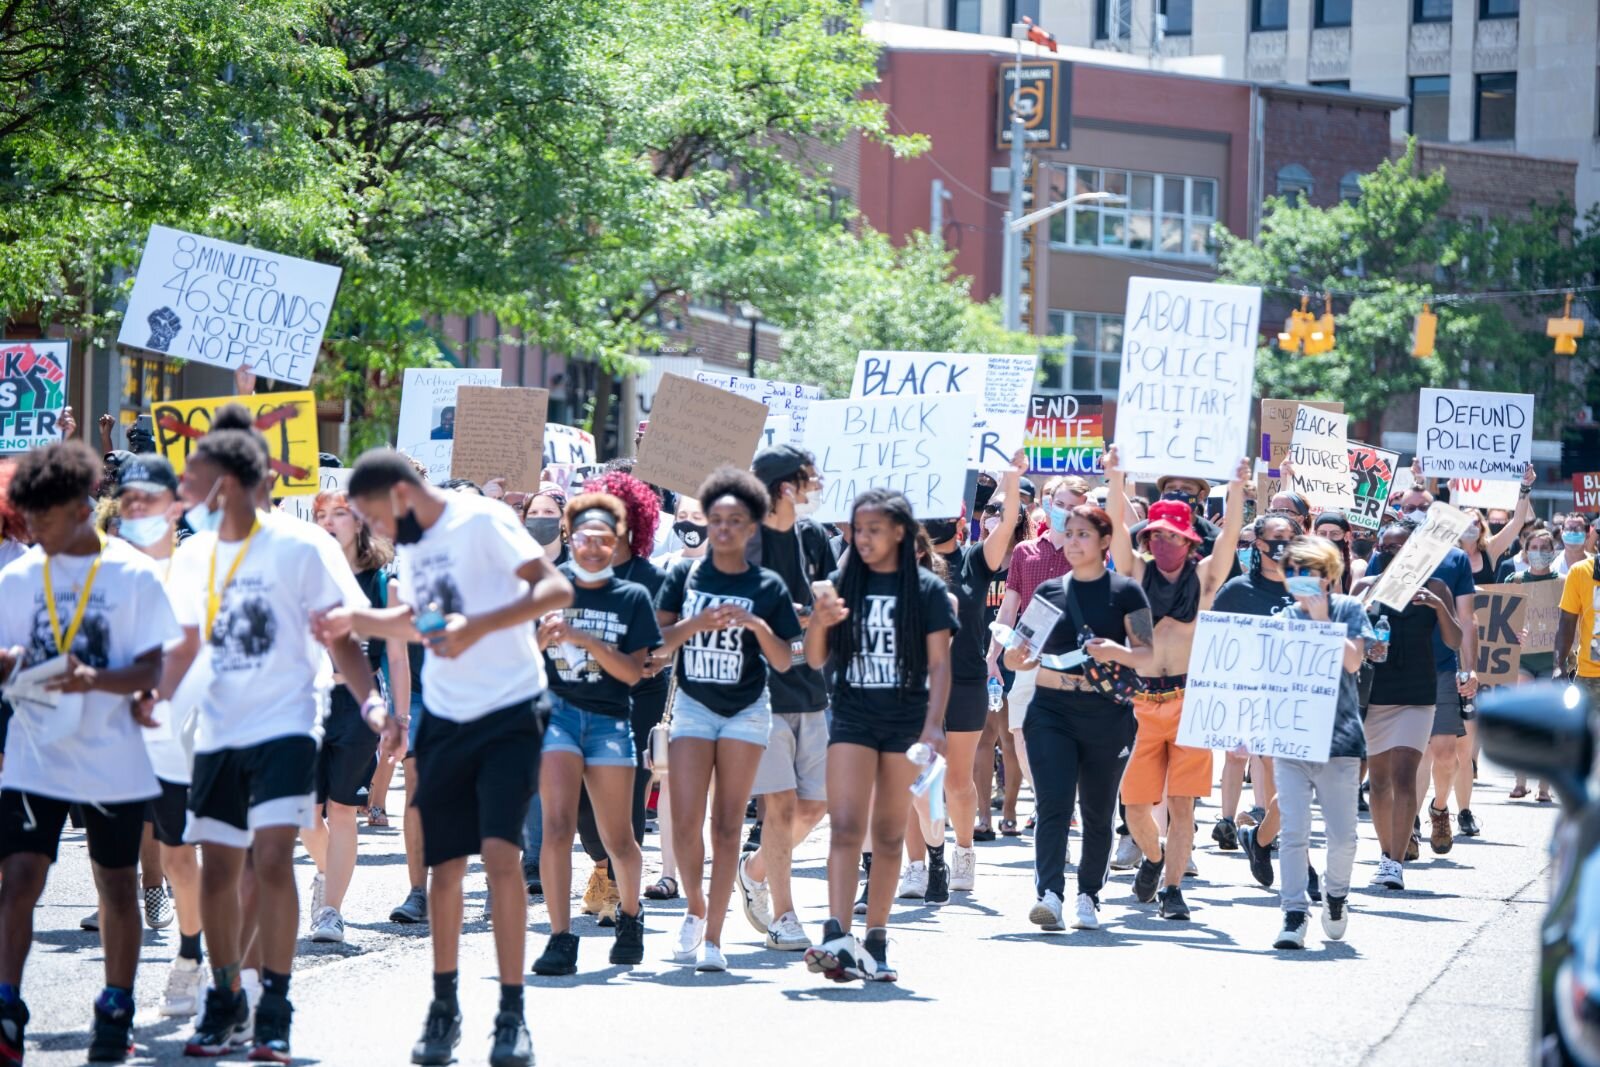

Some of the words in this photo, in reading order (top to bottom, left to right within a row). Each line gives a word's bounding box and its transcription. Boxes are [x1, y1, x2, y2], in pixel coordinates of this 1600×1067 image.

[172, 235, 197, 269] 8
[196, 246, 279, 287] MINUTES
[163, 270, 210, 312] 46
[212, 279, 326, 334] SECONDS
[1132, 290, 1252, 347] ABOLISH
[192, 314, 226, 336] NO
[227, 320, 315, 356] JUSTICE
[188, 333, 223, 360] NO
[225, 340, 305, 382] PEACE
[1127, 340, 1238, 386] POLICE,
[862, 357, 969, 396] BLACK
[843, 402, 938, 437] BLACK
[1032, 395, 1079, 419] END
[1295, 408, 1339, 438] BLACK
[1435, 396, 1525, 429] DEFUND
[822, 439, 930, 473] LIVES
[1028, 446, 1104, 474] ILENCE
[1136, 430, 1214, 464] ICE
[1288, 443, 1348, 473] FUTURES
[1427, 427, 1522, 459] POLICE!
[1422, 456, 1455, 472] FUND
[1459, 461, 1478, 471] OUR
[1292, 475, 1351, 496] MATTER
[1202, 629, 1240, 674] NO
[1250, 633, 1342, 680] JUSTICE
[1189, 694, 1227, 735] NO
[1238, 698, 1309, 732] PEACE
[1204, 734, 1243, 749] ABOLISH
[1250, 736, 1266, 752] THE
[1273, 737, 1311, 758] POLICE
